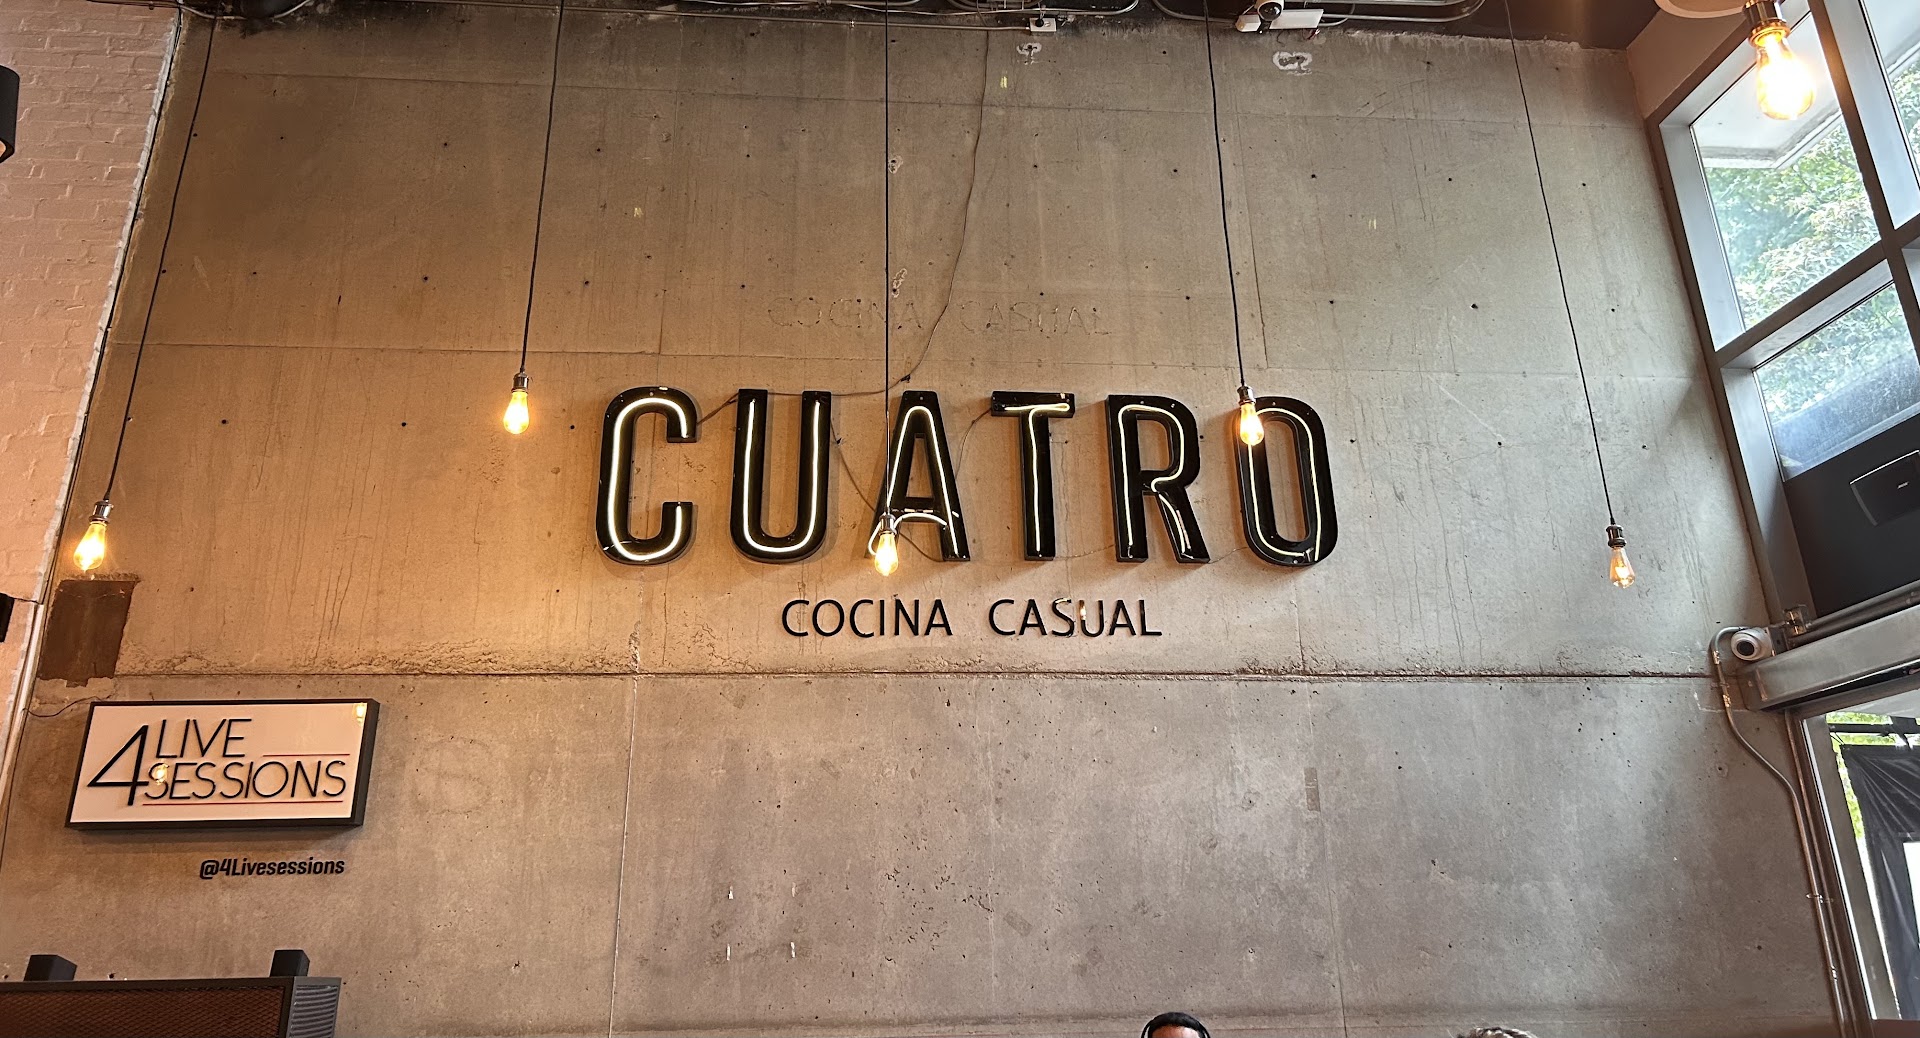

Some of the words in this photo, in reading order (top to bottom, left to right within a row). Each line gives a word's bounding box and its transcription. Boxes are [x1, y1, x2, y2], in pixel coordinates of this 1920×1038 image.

[596, 386, 1339, 567] CUATRO
[780, 597, 954, 639] COCINA
[987, 597, 1163, 639] CASUAL
[86, 723, 150, 806] 4
[154, 717, 253, 760] LIVE
[143, 759, 348, 800] SESSIONS
[199, 857, 345, 880] @4Livesessions
